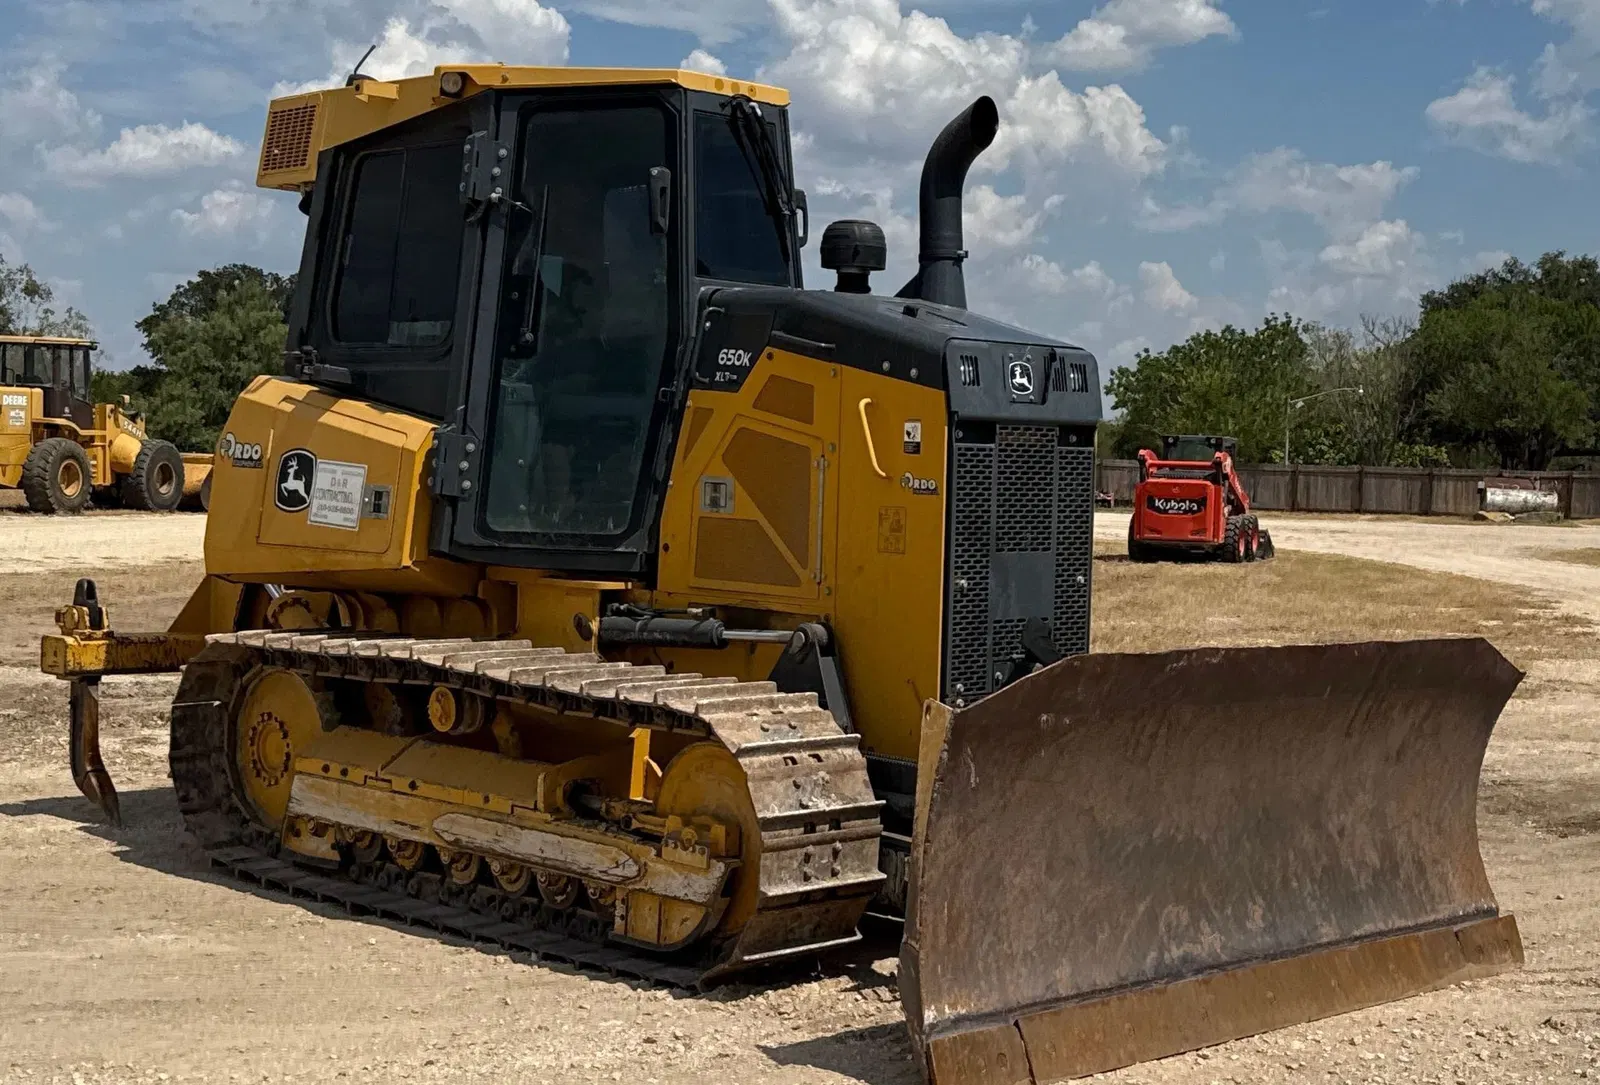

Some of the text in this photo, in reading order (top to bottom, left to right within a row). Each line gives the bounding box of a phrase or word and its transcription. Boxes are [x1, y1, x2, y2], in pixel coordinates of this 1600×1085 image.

[718, 348, 752, 367] 650K
[2, 394, 28, 406] DEERE
[123, 420, 143, 438] 544H
[234, 443, 262, 460] RDO
[330, 476, 337, 487] D
[1155, 498, 1198, 511] Kubota
